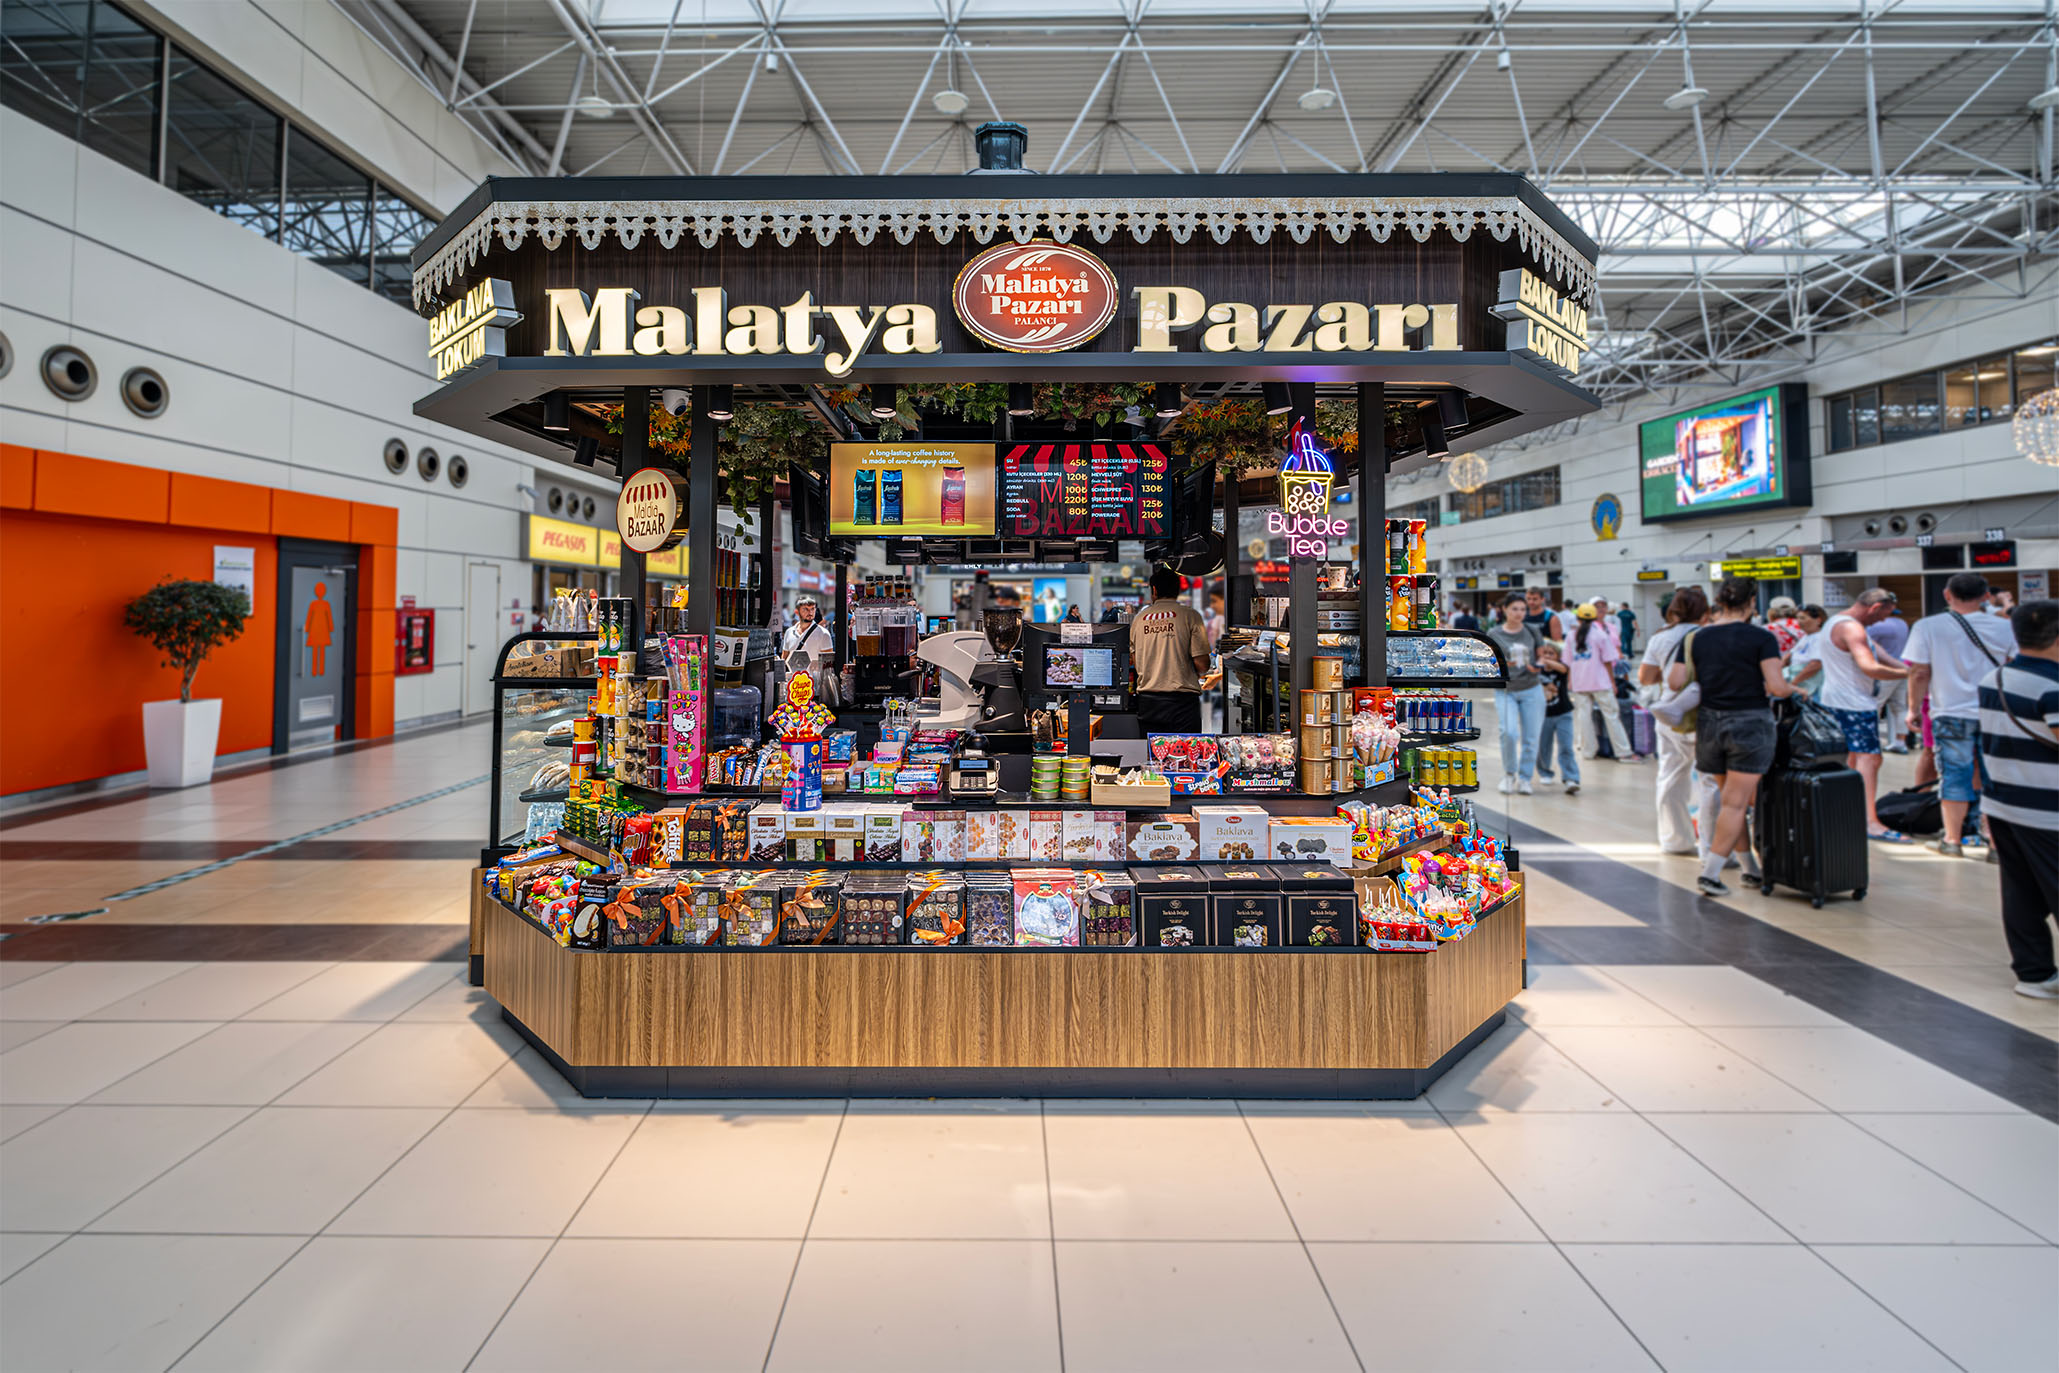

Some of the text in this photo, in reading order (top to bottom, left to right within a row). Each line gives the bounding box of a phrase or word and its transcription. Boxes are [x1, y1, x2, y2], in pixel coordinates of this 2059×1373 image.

[981, 274, 1089, 298] Malatya
[990, 296, 1083, 314] Pazarı
[1520, 268, 1587, 340] BAKLAVA
[430, 277, 494, 346] BAKLAVA
[1014, 317, 1057, 325] PALANCI
[1134, 286, 1459, 353] Pazarı
[545, 286, 942, 376] Malatya
[438, 325, 485, 380] LOKUM
[1528, 319, 1579, 376] LOKUM
[876, 450, 911, 458] long-lasting
[934, 450, 955, 458] history
[896, 458, 937, 467] ever-changing
[1065, 486, 1088, 494] 100₺
[1064, 496, 1088, 504] 220₺
[1142, 500, 1163, 508] 125₺
[1015, 498, 1163, 535] BAZAAR
[628, 513, 665, 537] BAZAAR
[1268, 513, 1348, 536] Bubble
[1917, 536, 1932, 546] 337
[1986, 530, 2004, 541] 338
[542, 531, 586, 552] PEGASUS
[1285, 535, 1326, 555] Tea
[1144, 623, 1174, 634] BAZAAR
[792, 681, 810, 690] Chupa
[671, 692, 698, 700] HELLO
[792, 690, 810, 699] Chups
[672, 701, 696, 710] KITTY
[709, 759, 718, 780] TWIX
[1232, 778, 1292, 787] Marshmallow
[1144, 832, 1182, 840] Baklava
[1216, 827, 1253, 836] Baklava
[667, 817, 680, 864] Toffifee
